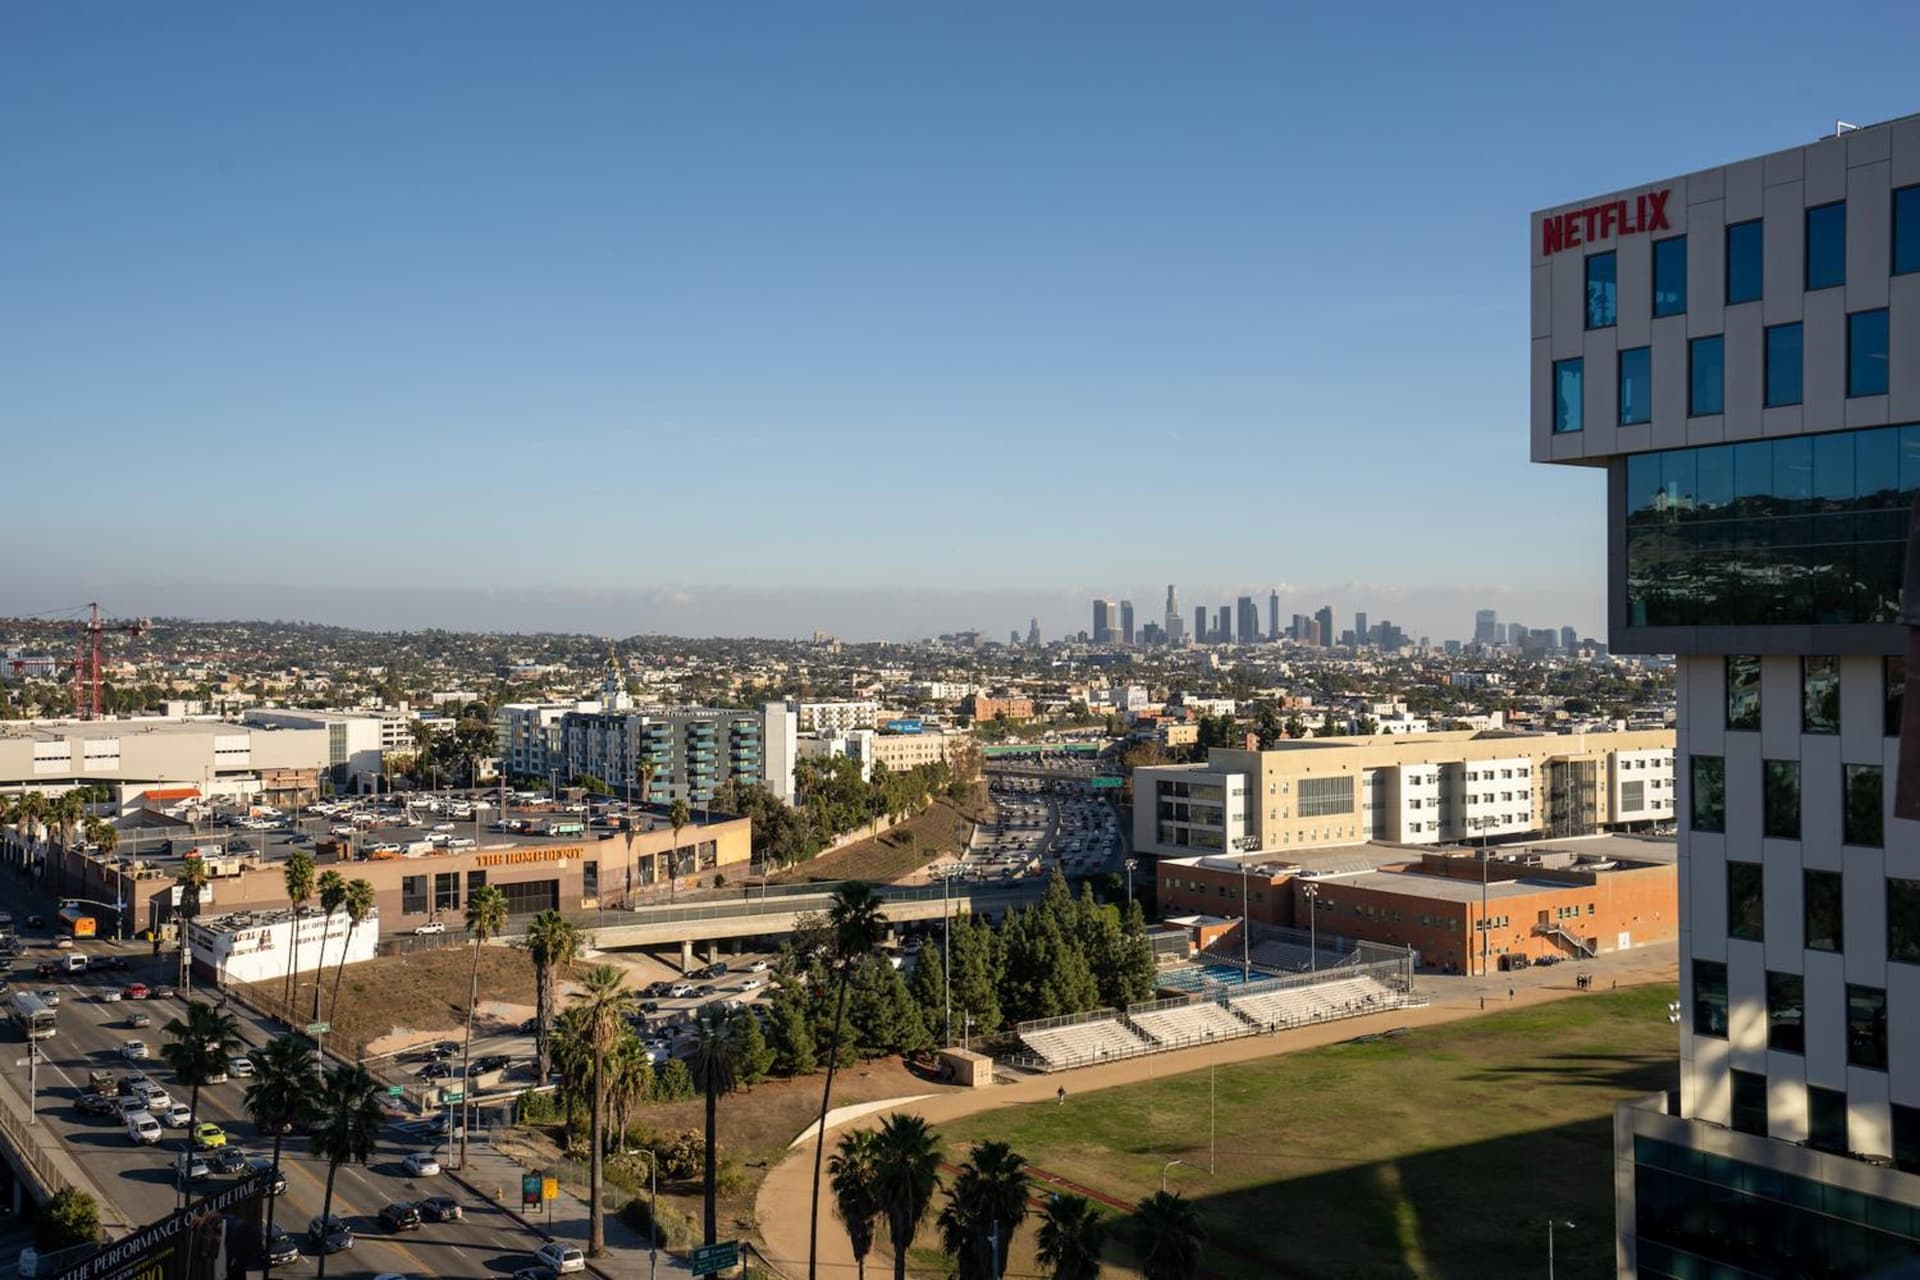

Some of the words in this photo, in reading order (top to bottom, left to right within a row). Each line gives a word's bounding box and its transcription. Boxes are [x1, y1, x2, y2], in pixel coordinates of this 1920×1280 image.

[1542, 190, 1670, 256] NETFLIX
[475, 853, 502, 867] THE
[505, 851, 541, 865] HOME
[543, 847, 584, 861] DEPOT
[94, 1214, 181, 1274] PERFORMANCE
[184, 1207, 199, 1227] OF
